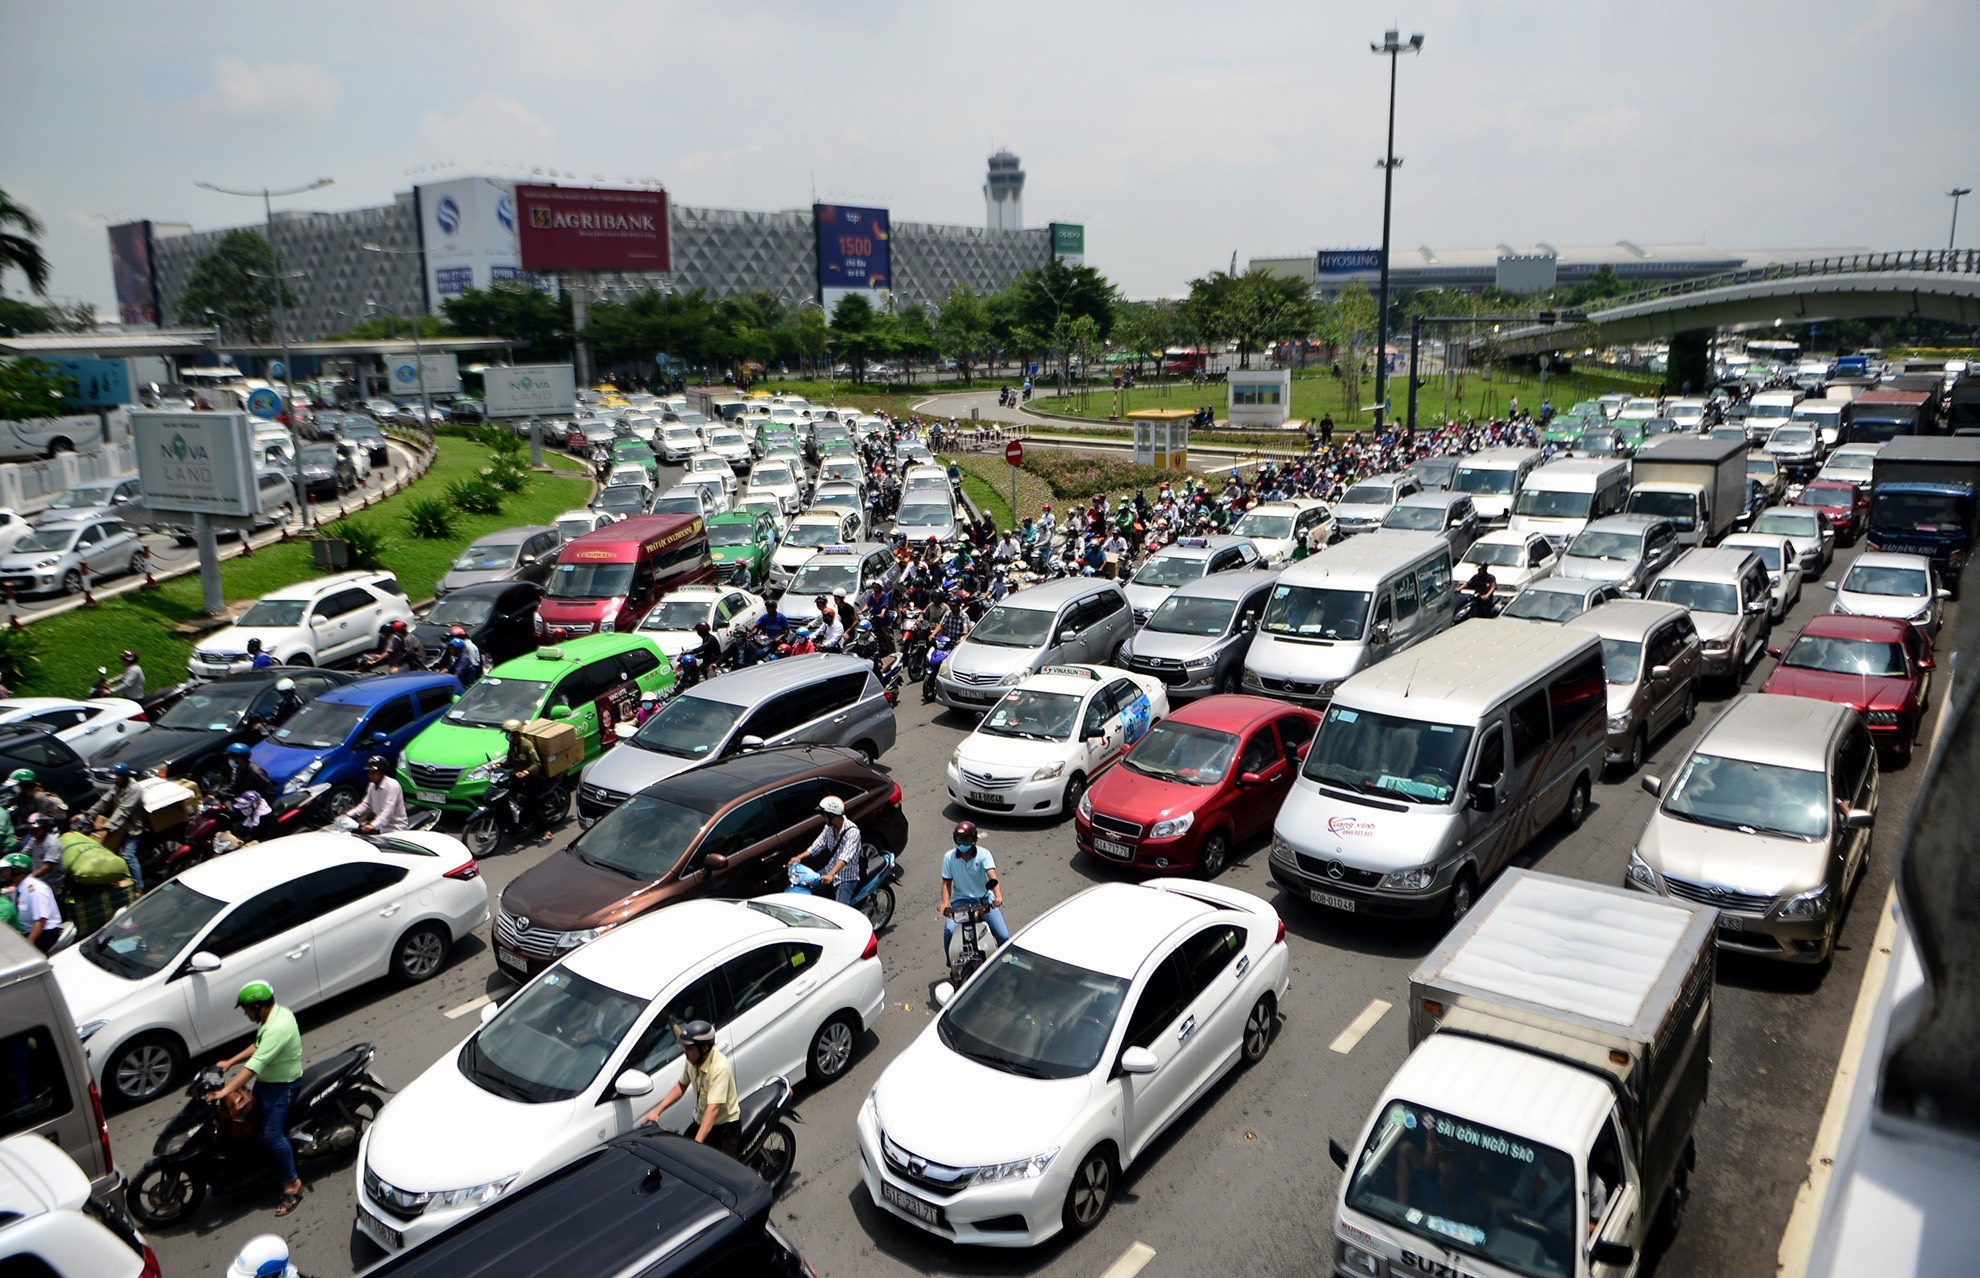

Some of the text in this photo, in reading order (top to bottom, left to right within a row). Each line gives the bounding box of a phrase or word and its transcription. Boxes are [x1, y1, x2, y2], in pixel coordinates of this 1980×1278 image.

[553, 208, 655, 231] AGRIBANK
[840, 236, 872, 256] 1500
[1321, 254, 1379, 267] HYOSUNG
[163, 466, 213, 483] LAND
[1053, 667, 1079, 676] VINASUN
[1456, 1124, 1480, 1146] GÒN
[1481, 1132, 1510, 1156] NGÔI
[1510, 1142, 1535, 1163] SAO
